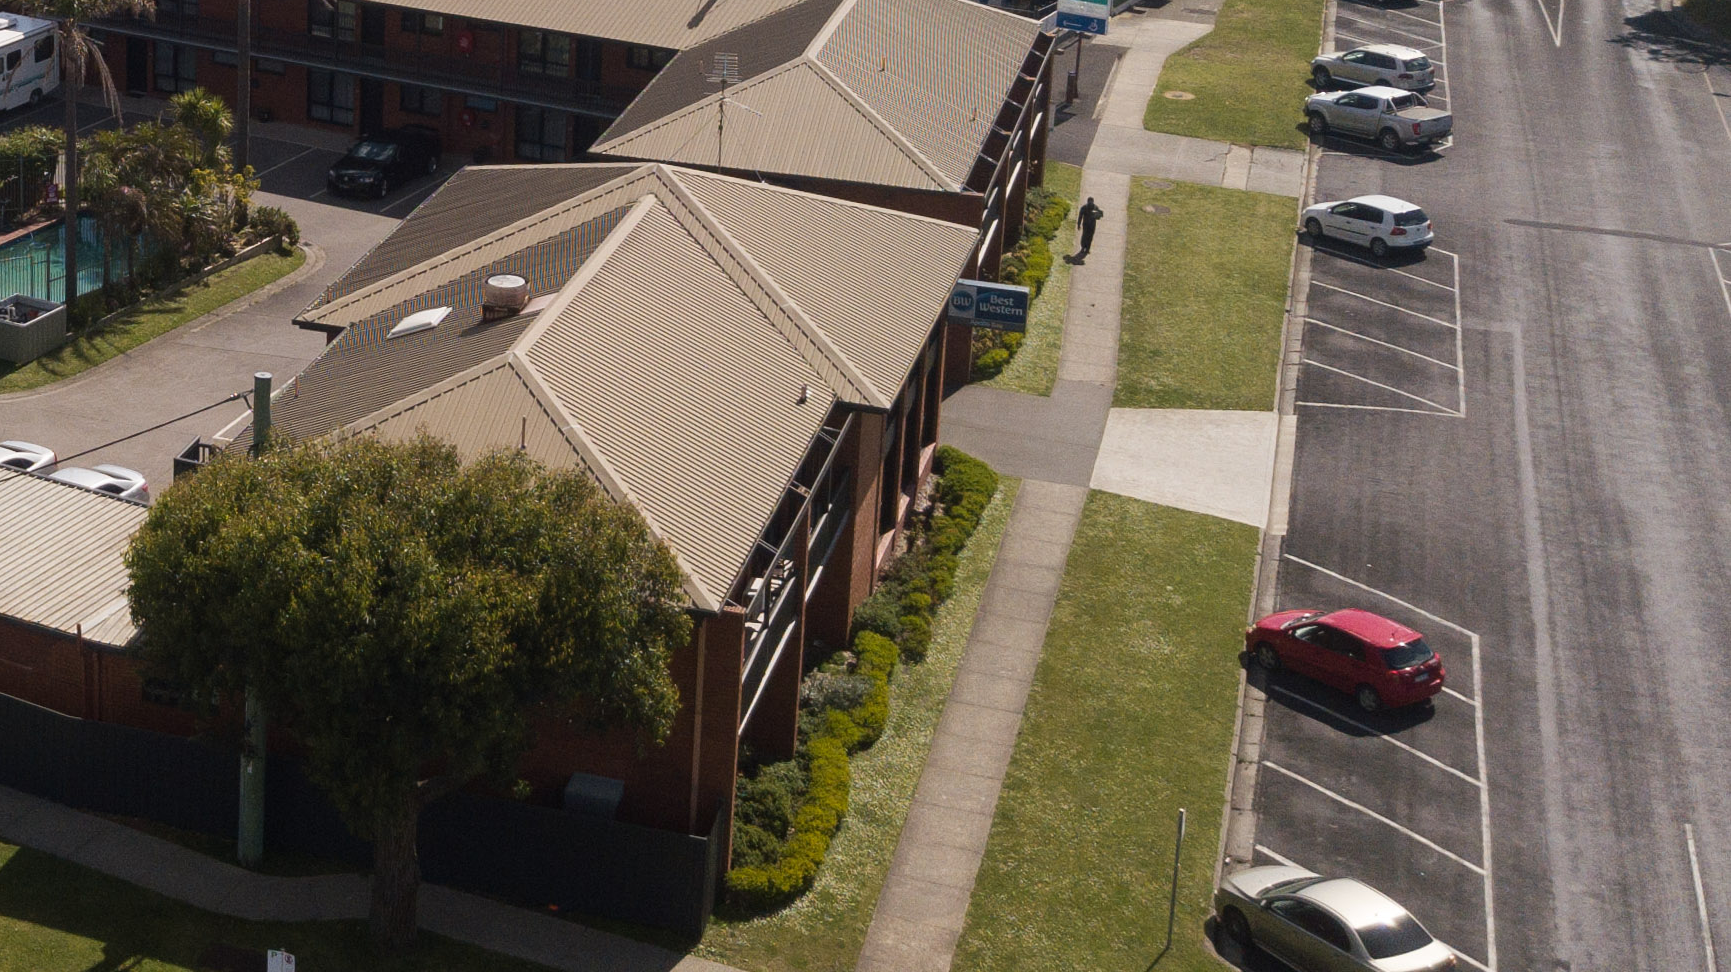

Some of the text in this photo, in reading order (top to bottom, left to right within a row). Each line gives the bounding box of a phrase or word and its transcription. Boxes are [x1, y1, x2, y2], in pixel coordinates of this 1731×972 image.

[953, 296, 971, 306] BW
[990, 294, 1014, 306] Best
[979, 302, 1023, 316] Western
